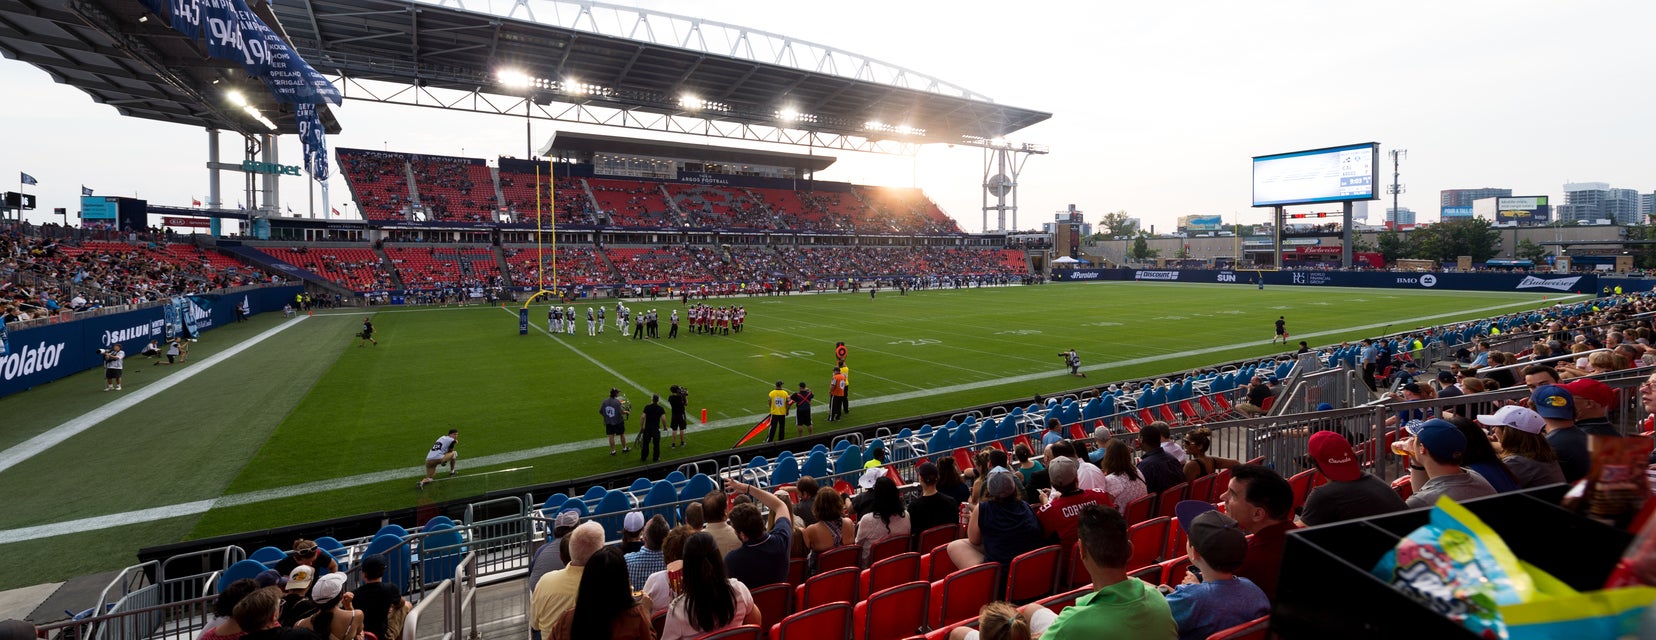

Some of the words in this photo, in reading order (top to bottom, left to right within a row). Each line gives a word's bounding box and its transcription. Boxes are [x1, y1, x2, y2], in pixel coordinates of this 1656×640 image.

[1217, 274, 1236, 282] SUN
[1522, 277, 1576, 288] Budweiser
[111, 323, 150, 344] SAILUN
[1328, 456, 1352, 464] Canada
